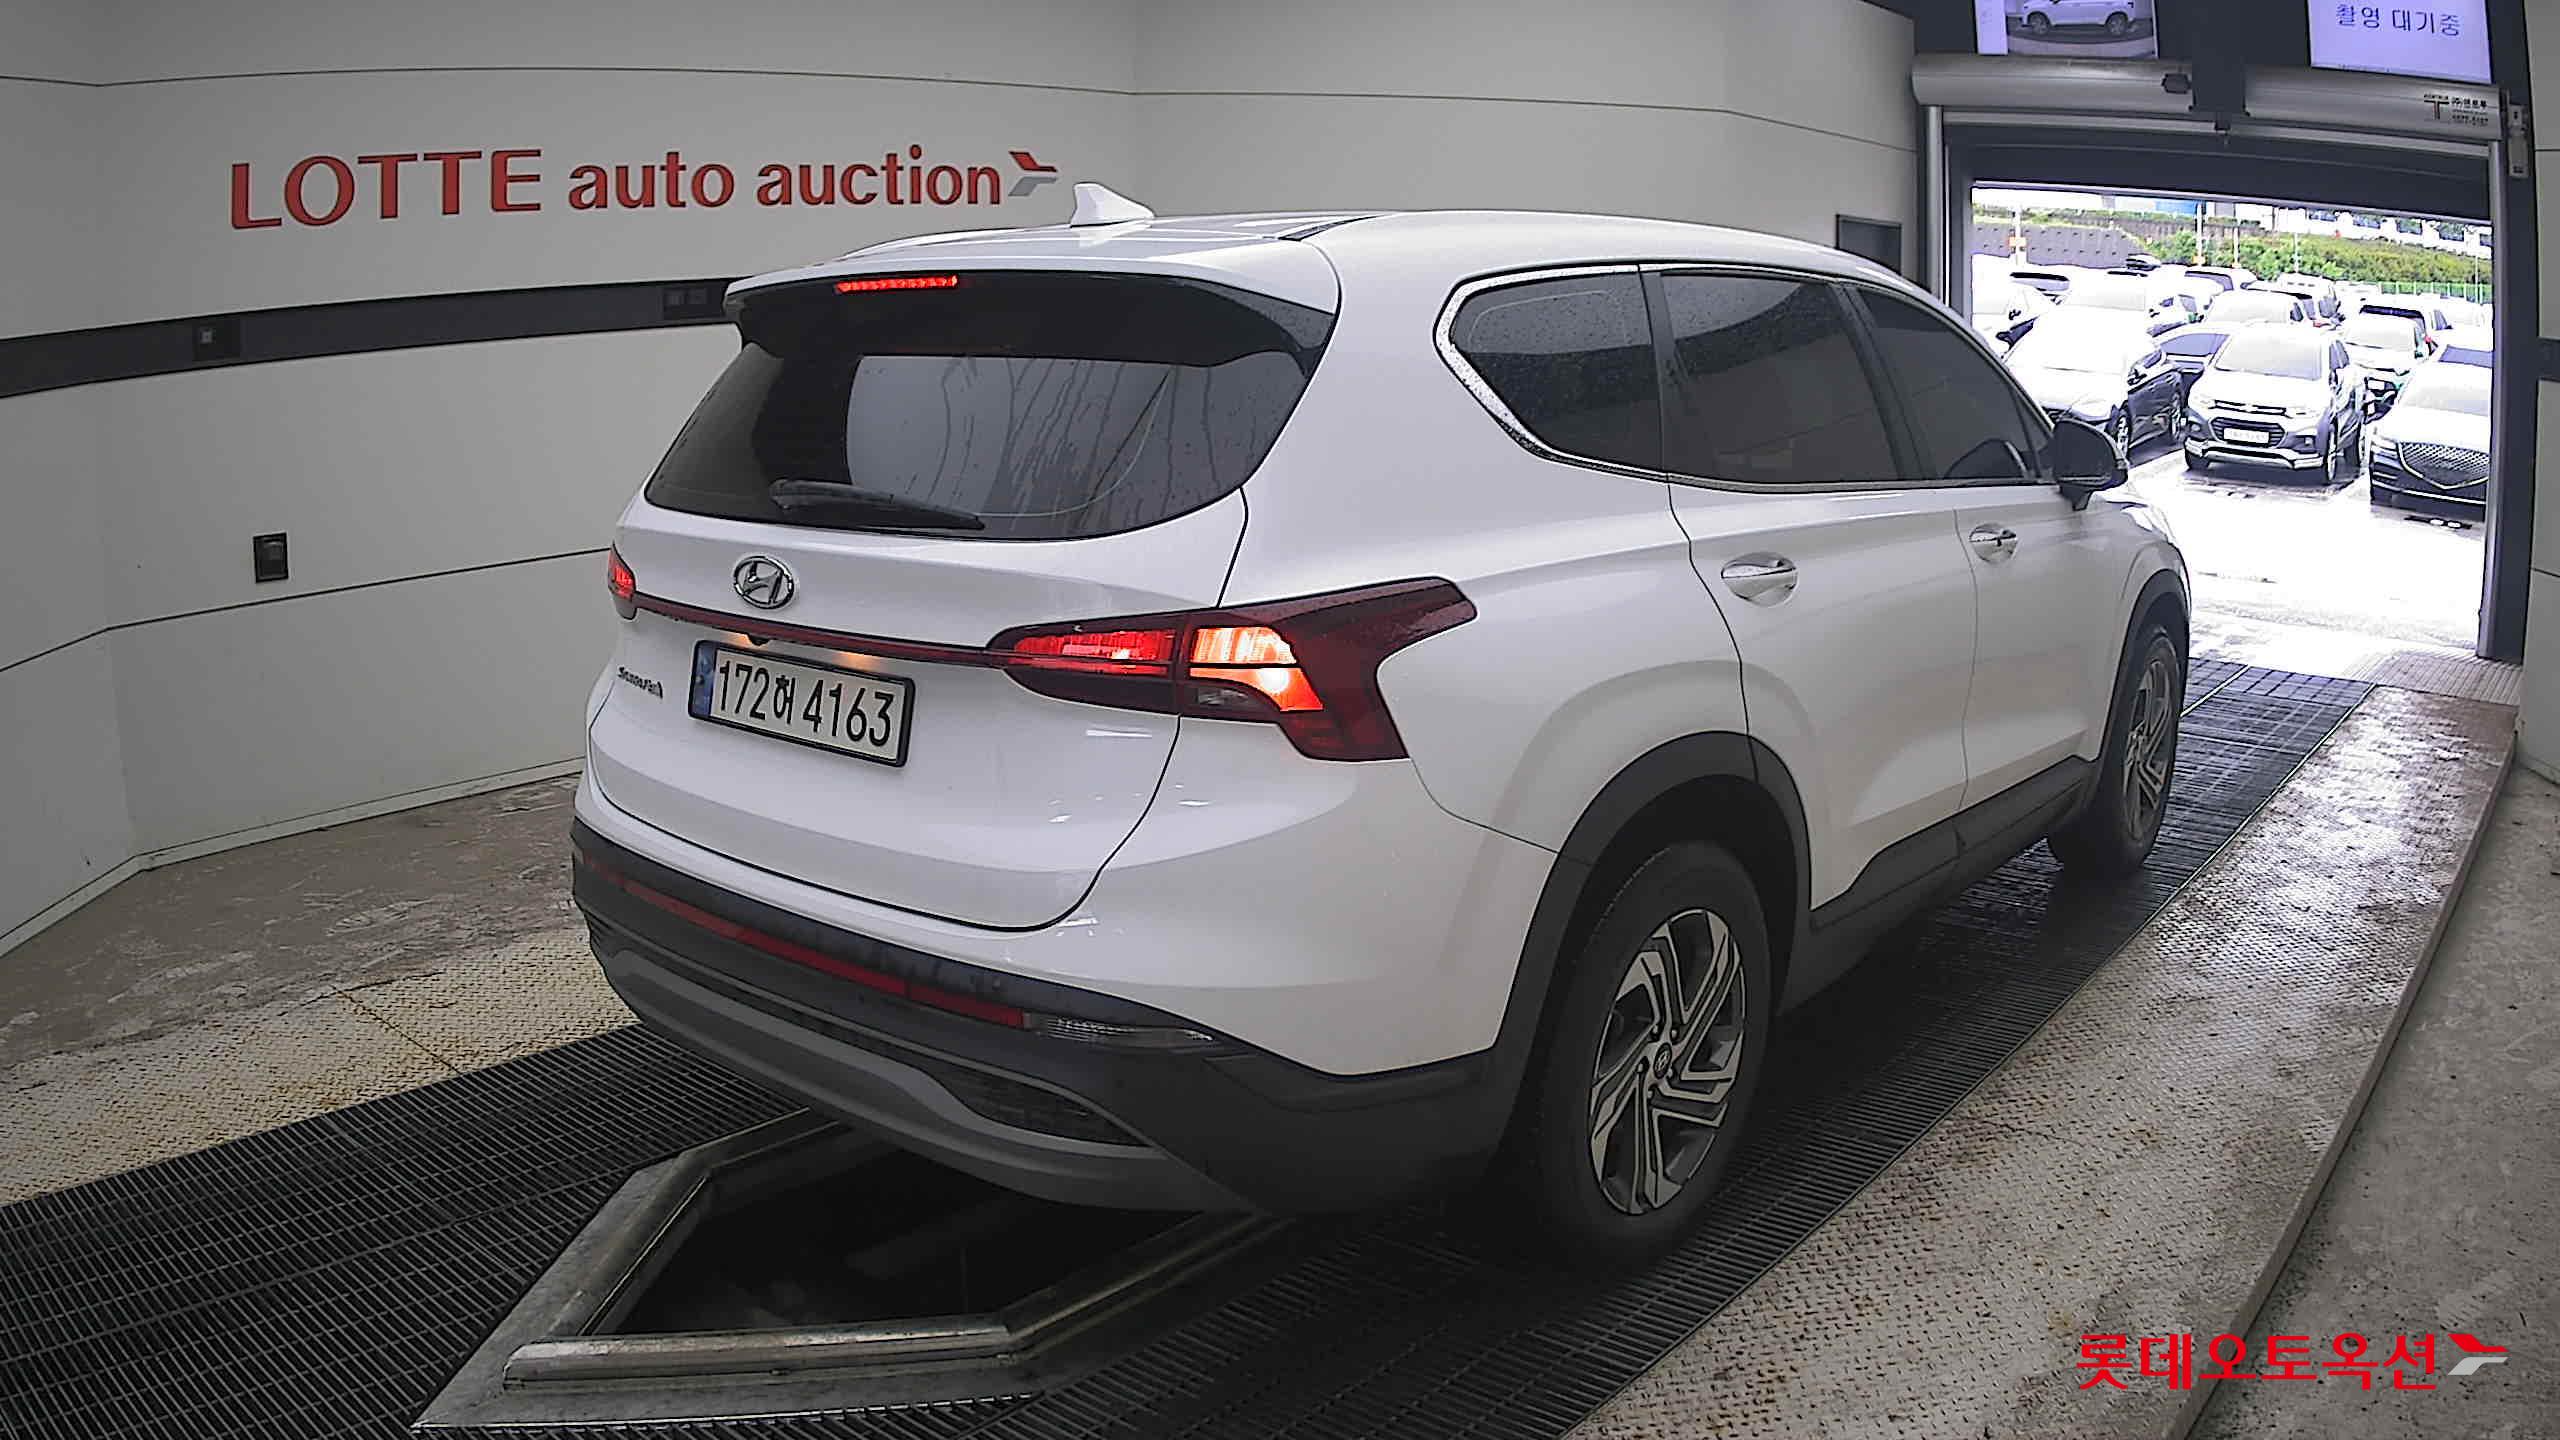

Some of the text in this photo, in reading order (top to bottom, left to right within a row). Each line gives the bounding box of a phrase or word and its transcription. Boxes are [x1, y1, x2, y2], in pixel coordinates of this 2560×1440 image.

[2336, 4, 2461, 37] 촬영 대기중
[231, 144, 1003, 230] LOTTE auto auction
[717, 659, 795, 726] 172허
[802, 678, 895, 748] 4163
